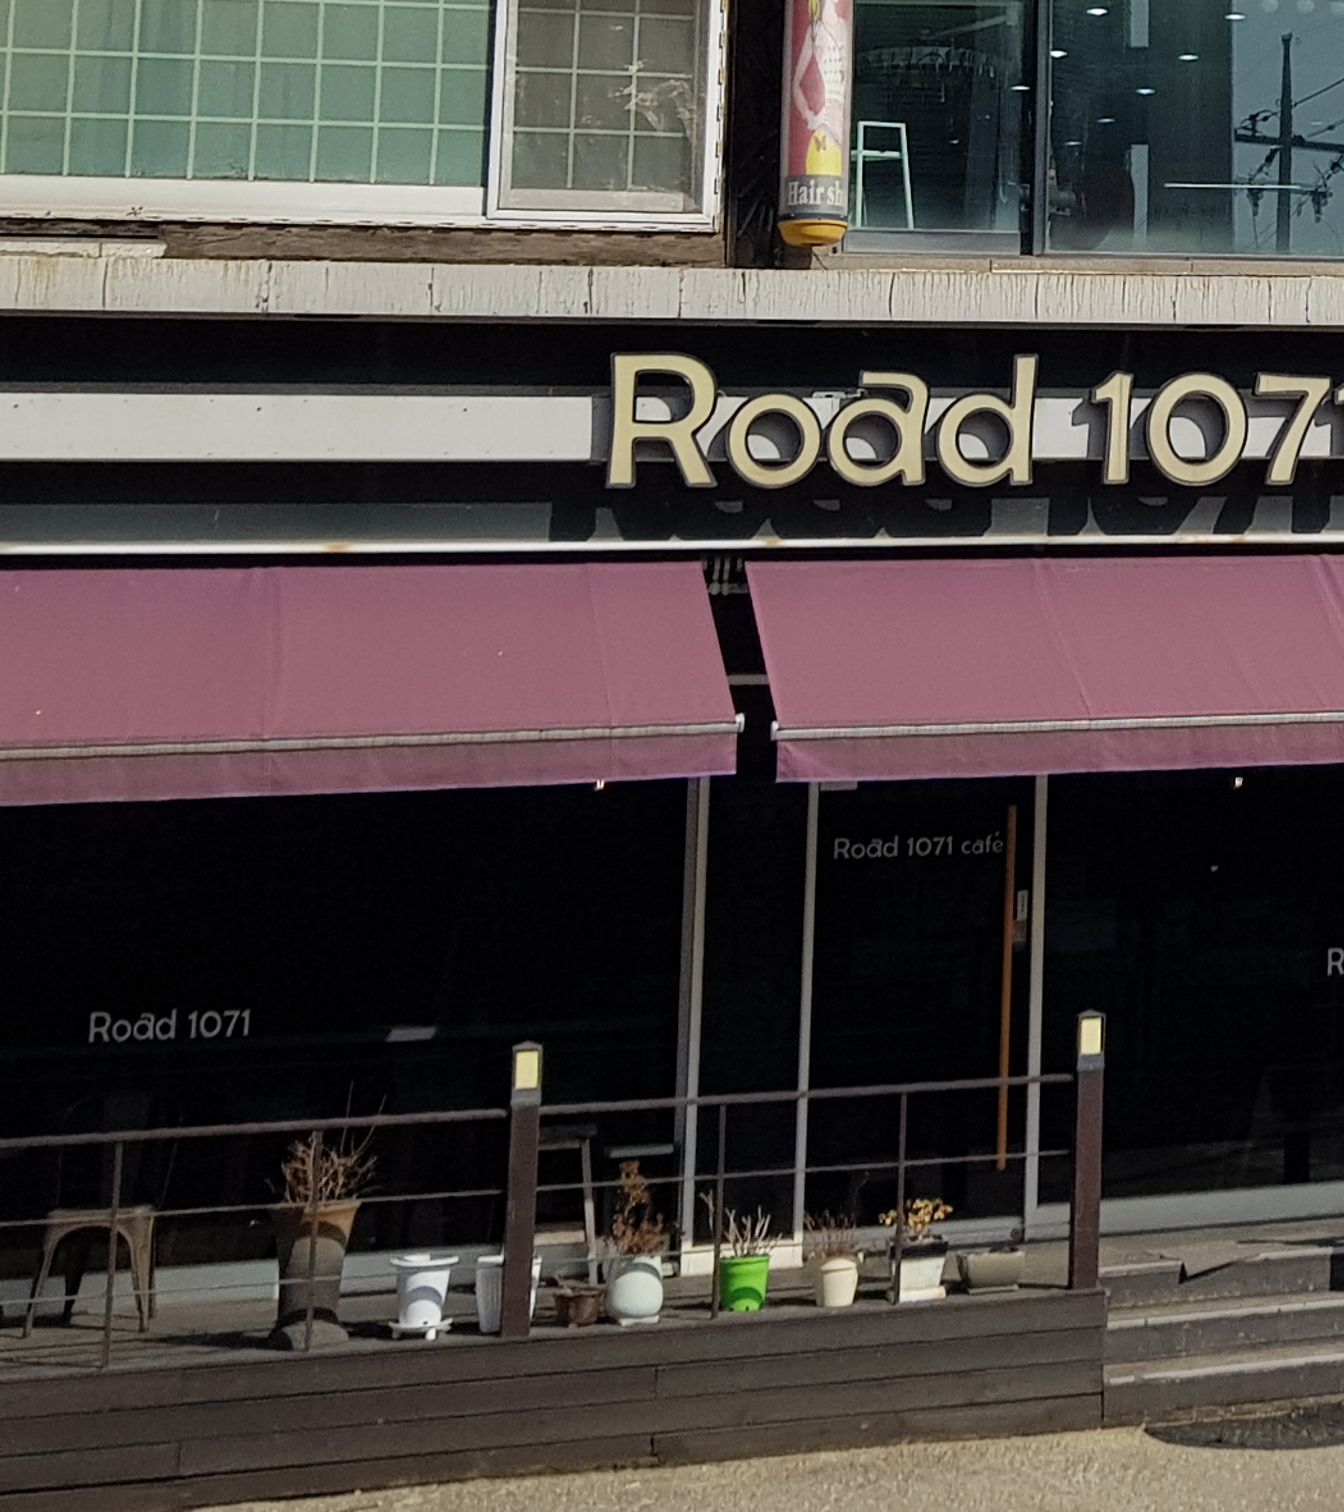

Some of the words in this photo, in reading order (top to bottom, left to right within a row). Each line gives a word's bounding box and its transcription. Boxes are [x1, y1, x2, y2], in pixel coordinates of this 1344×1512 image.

[788, 179, 825, 206] Hair
[606, 351, 1040, 488] Road
[832, 835, 899, 859] Road
[907, 835, 953, 856] 1071
[961, 831, 1003, 855] café
[88, 1008, 178, 1044] Road
[187, 1008, 251, 1039] 1071
